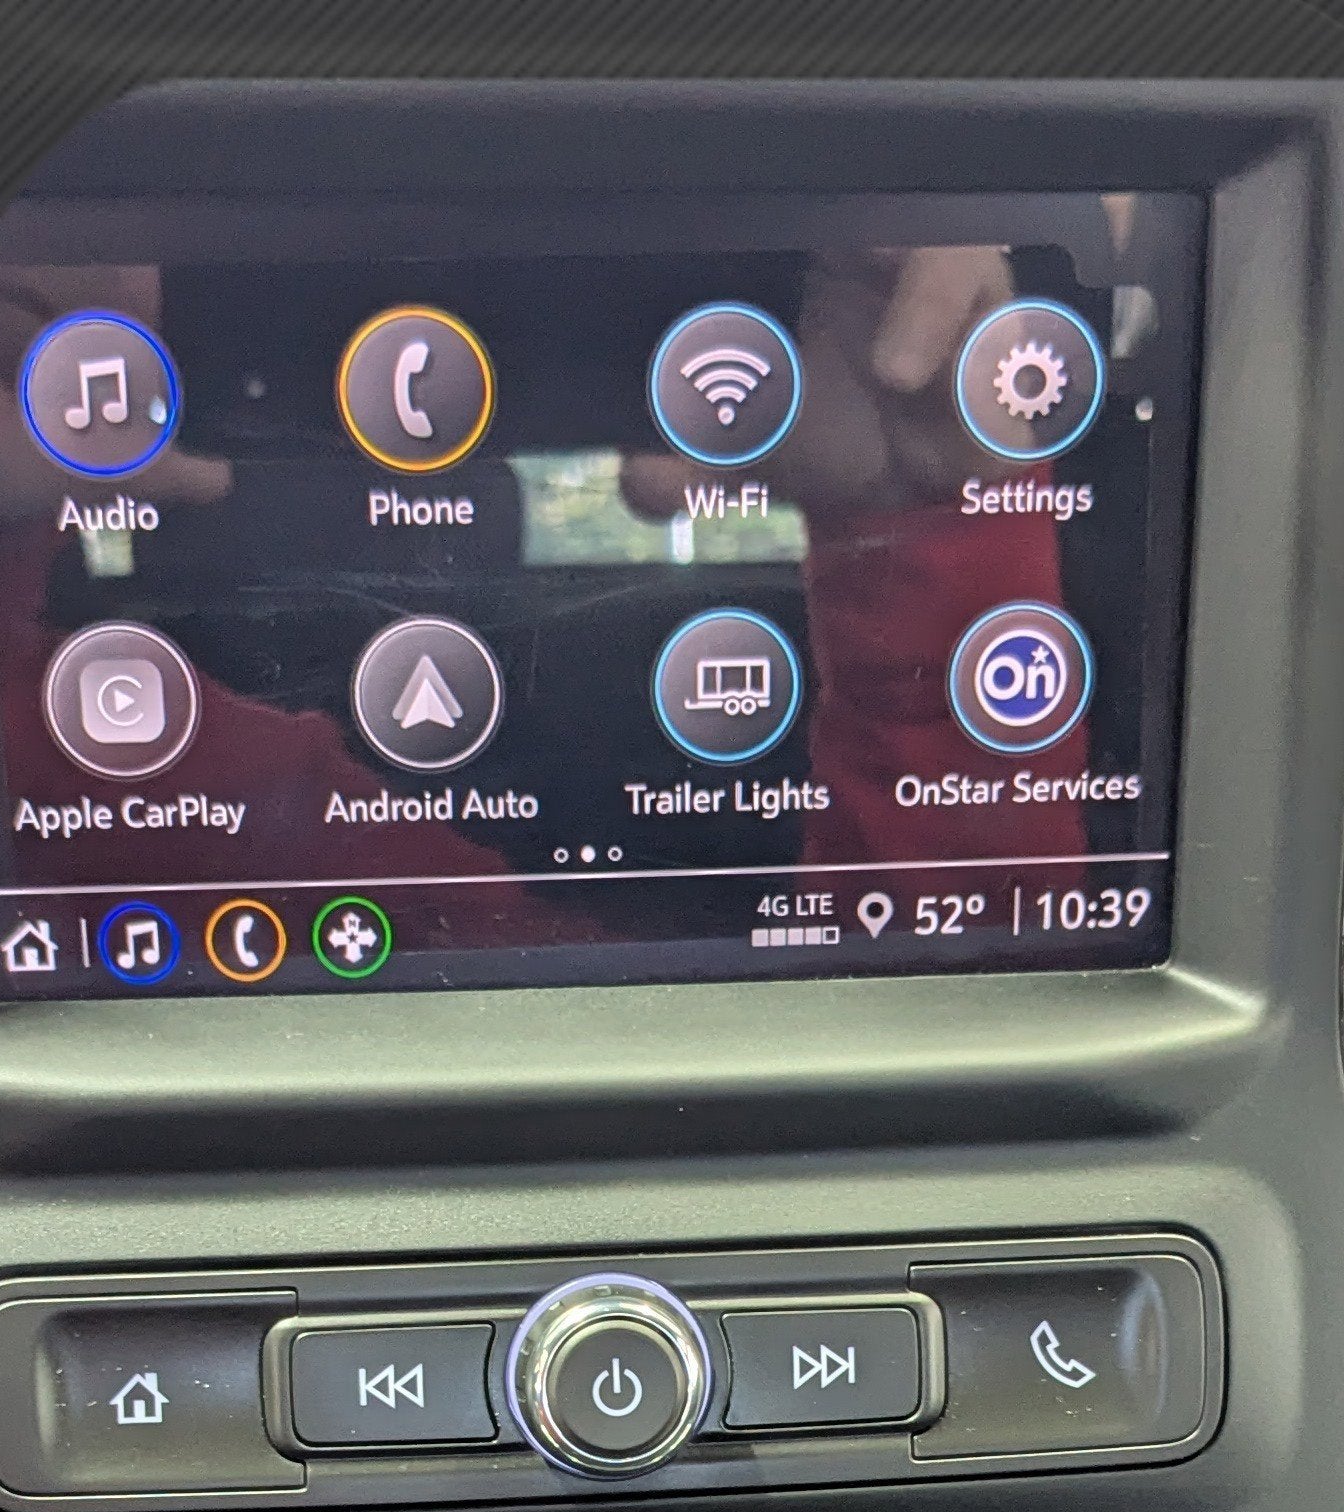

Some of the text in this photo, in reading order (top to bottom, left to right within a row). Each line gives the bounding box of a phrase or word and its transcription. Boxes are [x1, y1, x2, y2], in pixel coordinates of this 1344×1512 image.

[57, 494, 161, 534] Audio
[367, 487, 476, 527] Phone
[684, 485, 770, 519] Wi-Fi
[960, 478, 1094, 522] Settings
[323, 787, 540, 824] Android Auto
[623, 778, 831, 820] Trailer Lights
[894, 770, 1143, 808] OnStar Services
[14, 793, 247, 840] Apple CarPlay
[756, 892, 834, 918] 4G LTE
[1035, 886, 1152, 932] 10:39
